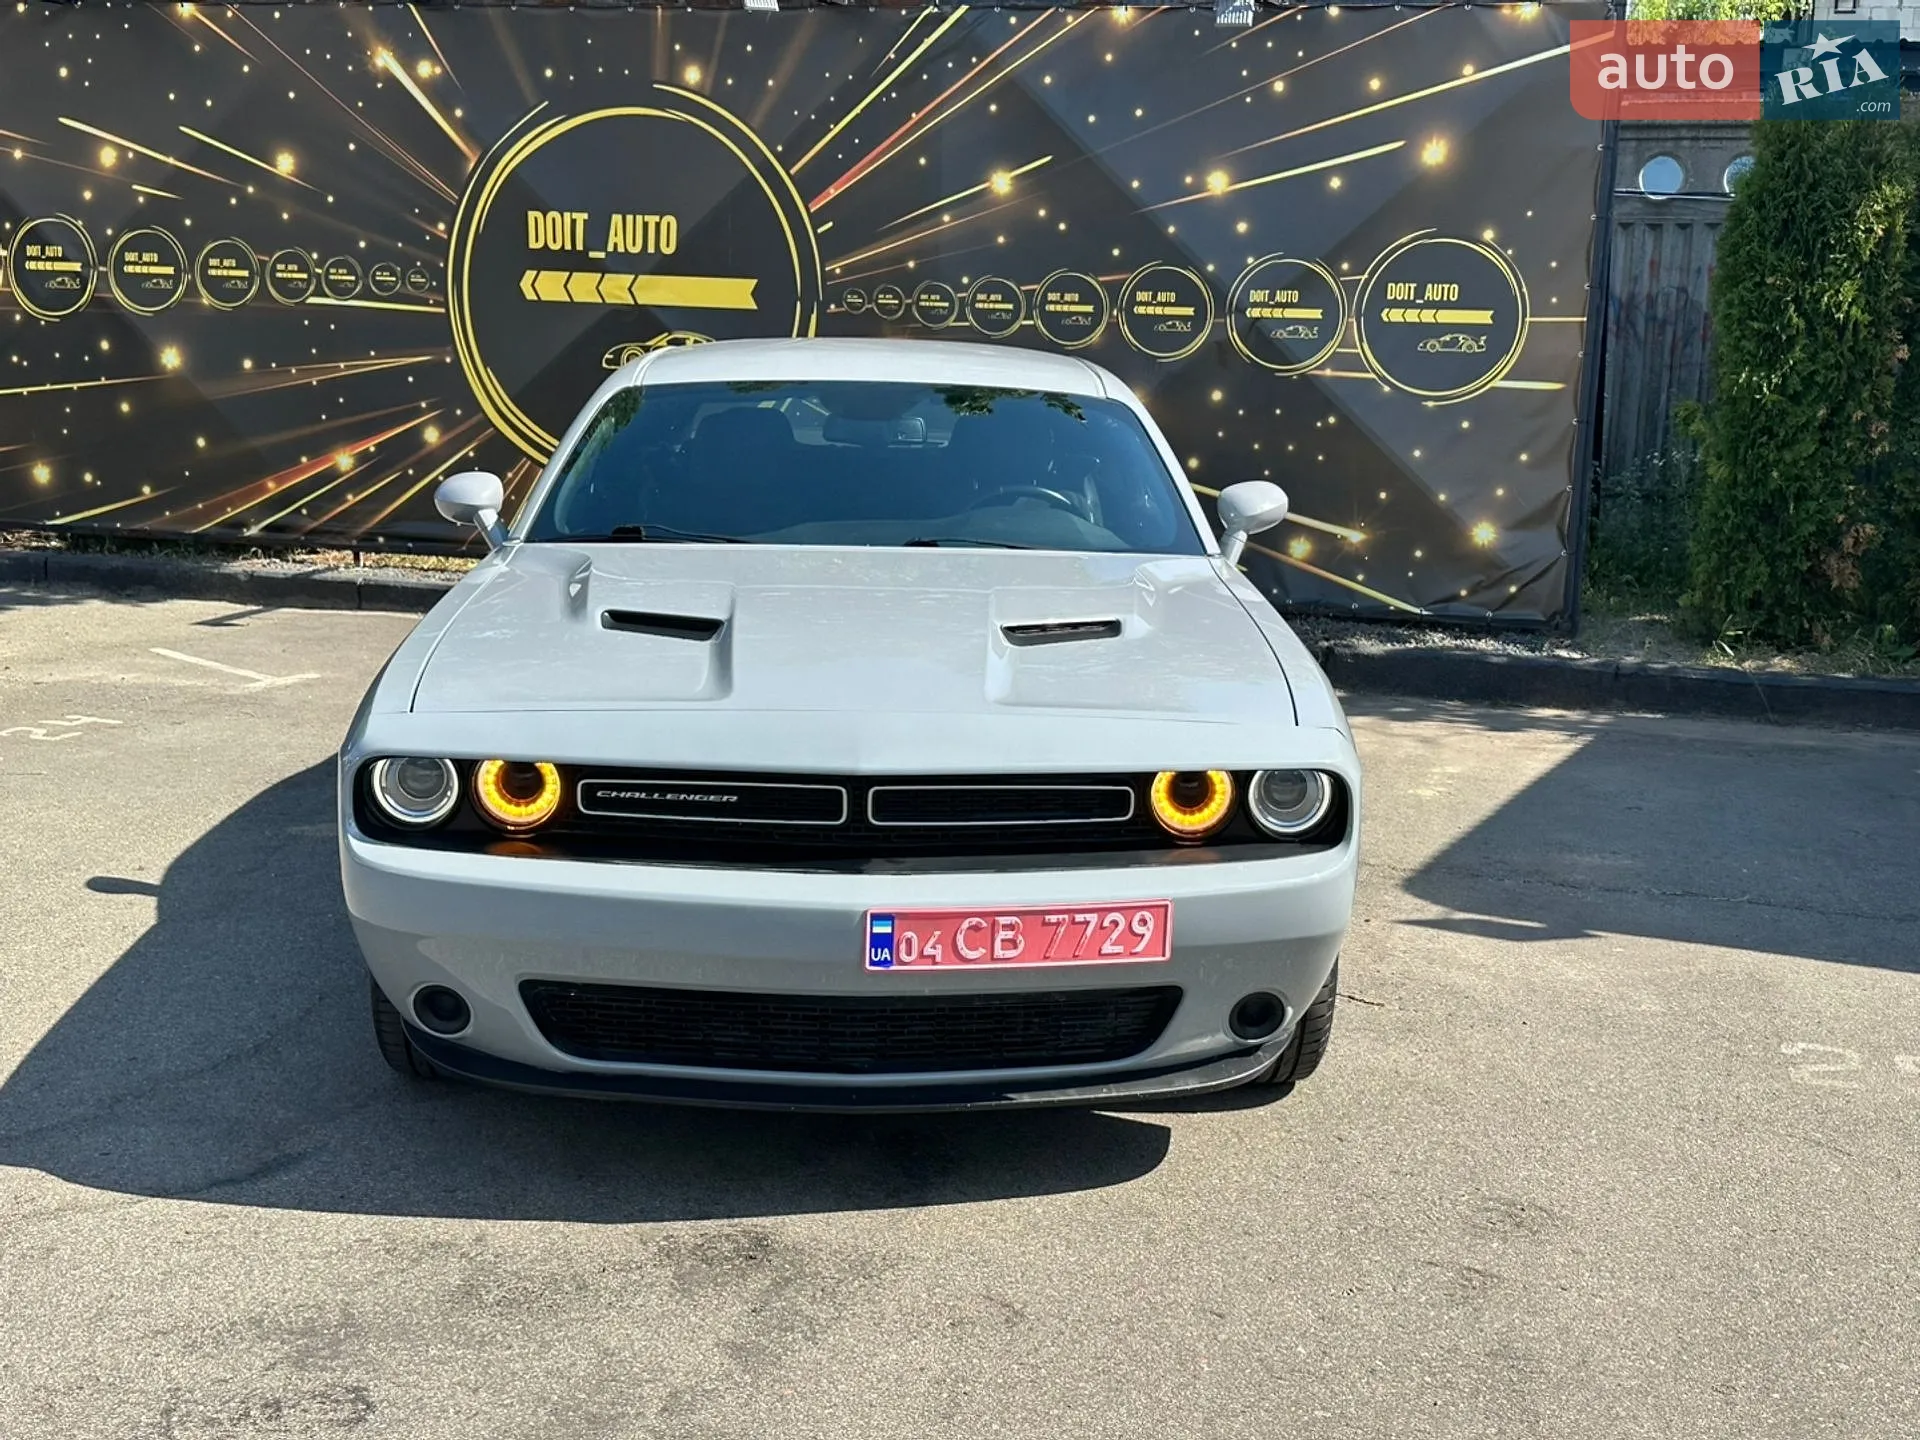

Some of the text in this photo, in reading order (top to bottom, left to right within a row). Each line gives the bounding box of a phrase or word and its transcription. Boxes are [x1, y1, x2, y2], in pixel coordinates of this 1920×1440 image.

[526, 210, 678, 259] DOIT_AUTO
[1135, 291, 1176, 304] DOIT_AUTO
[1249, 289, 1299, 305] DOIT_AUTO
[1386, 283, 1460, 304] DOIT_AUTO
[596, 790, 739, 803] CHALLENGER
[870, 910, 1155, 963] UA 04 CB 7729
